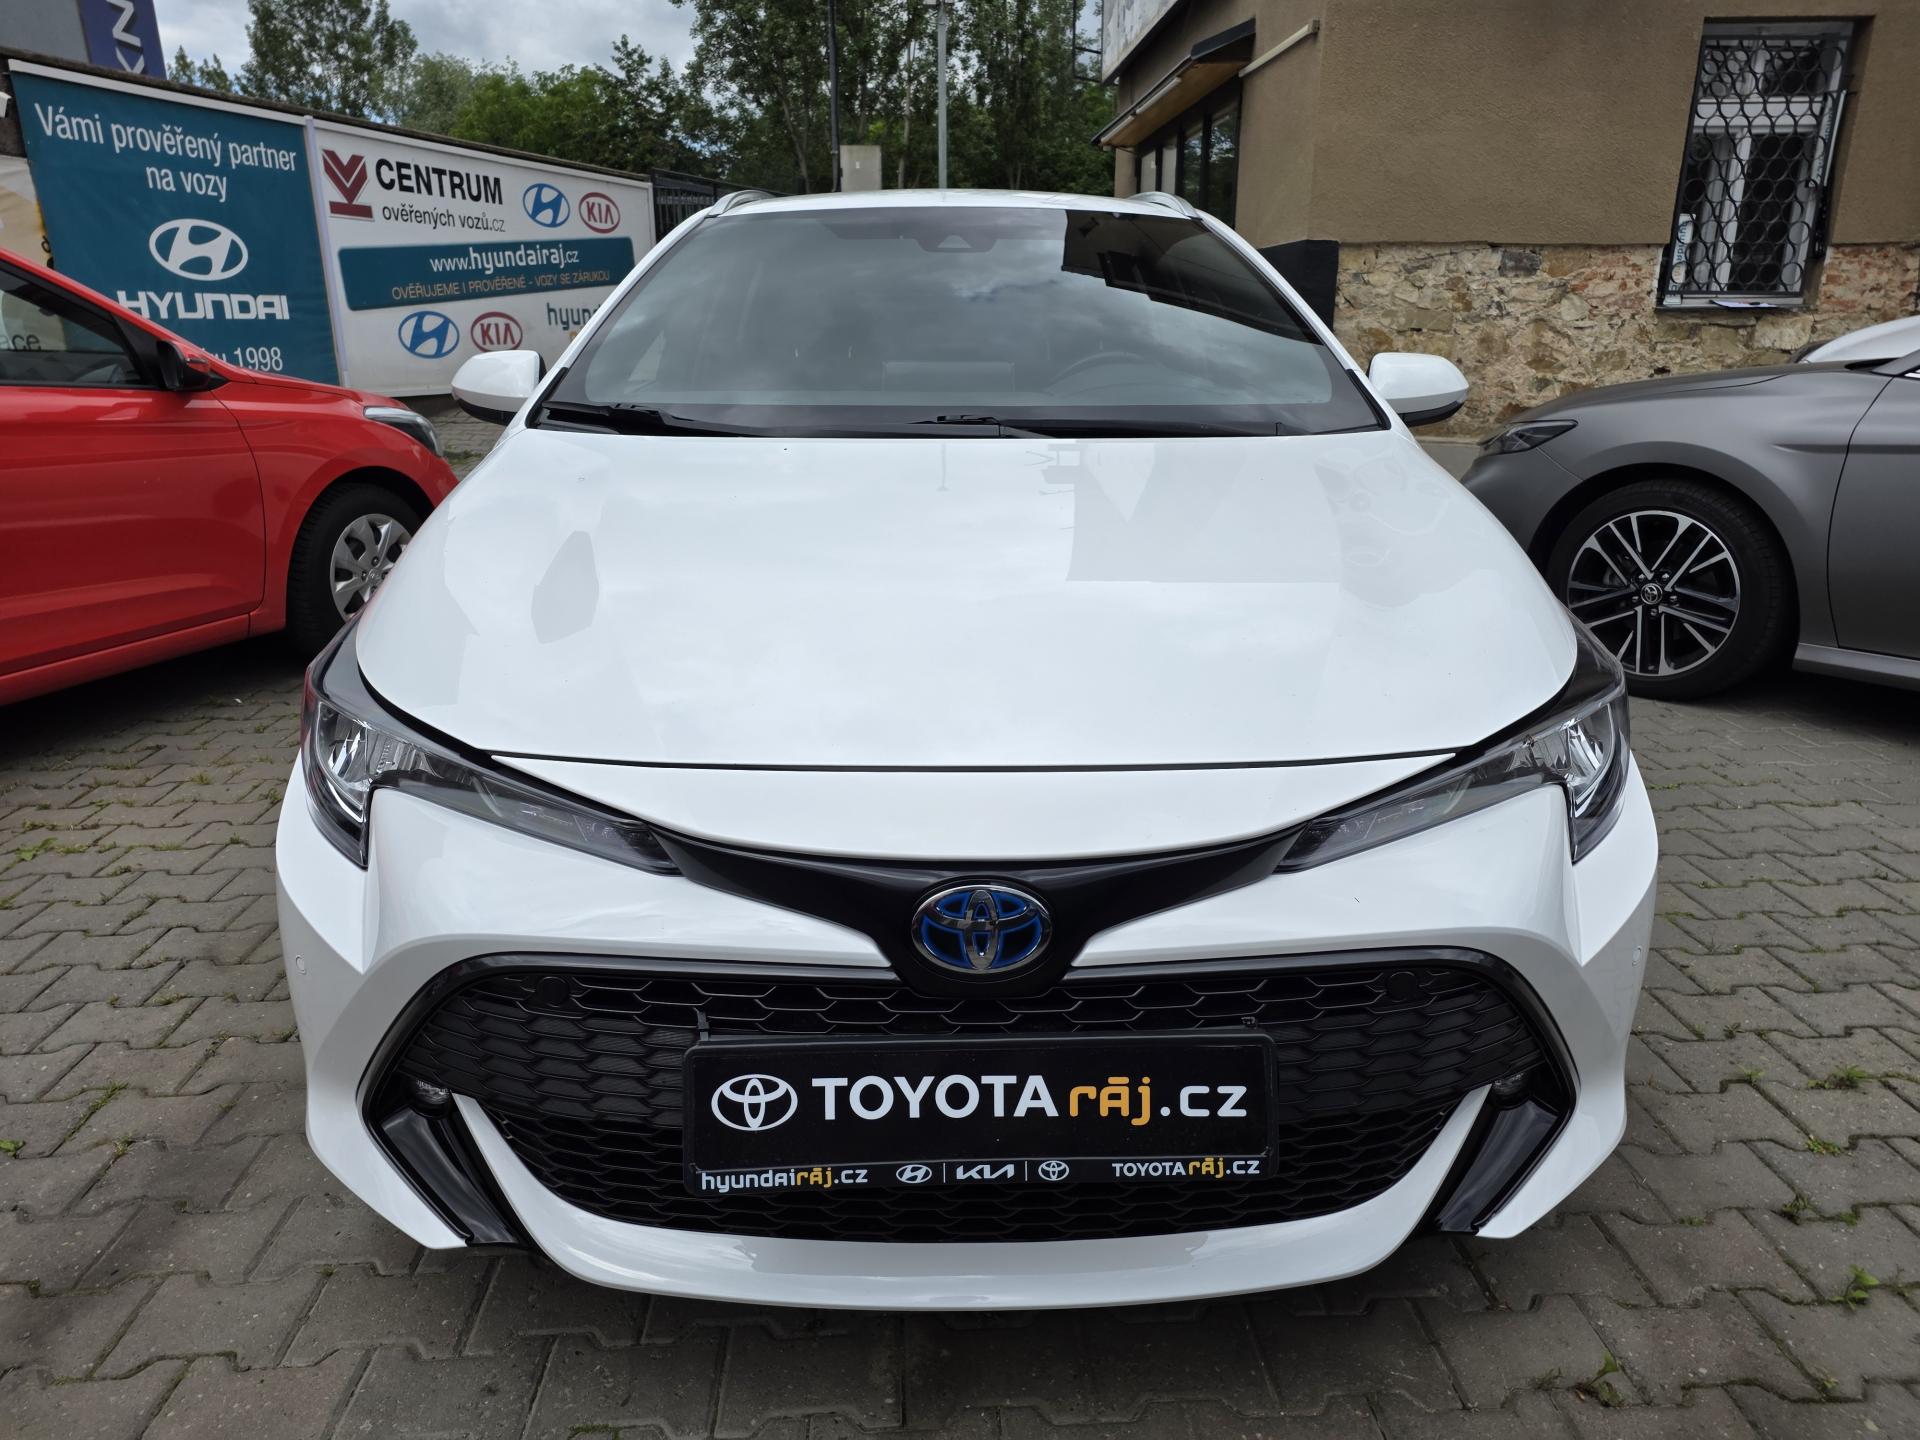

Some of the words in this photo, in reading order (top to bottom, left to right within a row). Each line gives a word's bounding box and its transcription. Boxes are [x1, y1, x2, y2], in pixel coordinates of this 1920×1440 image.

[34, 103, 103, 144] Vámi
[111, 123, 222, 166] prověřený
[228, 142, 296, 171] partner
[146, 166, 176, 192] na
[180, 172, 227, 202] vozy
[375, 158, 503, 205] CENTRUM
[383, 203, 455, 230] ověřených
[586, 200, 614, 225] KIA
[430, 243, 579, 275] www.hyundairaj.cz
[534, 274, 558, 287] VOZY
[560, 272, 571, 285] SE
[117, 290, 290, 320] HYUNDAI
[547, 303, 600, 331] hyun
[480, 322, 516, 346] KIA
[233, 347, 283, 371] 1998
